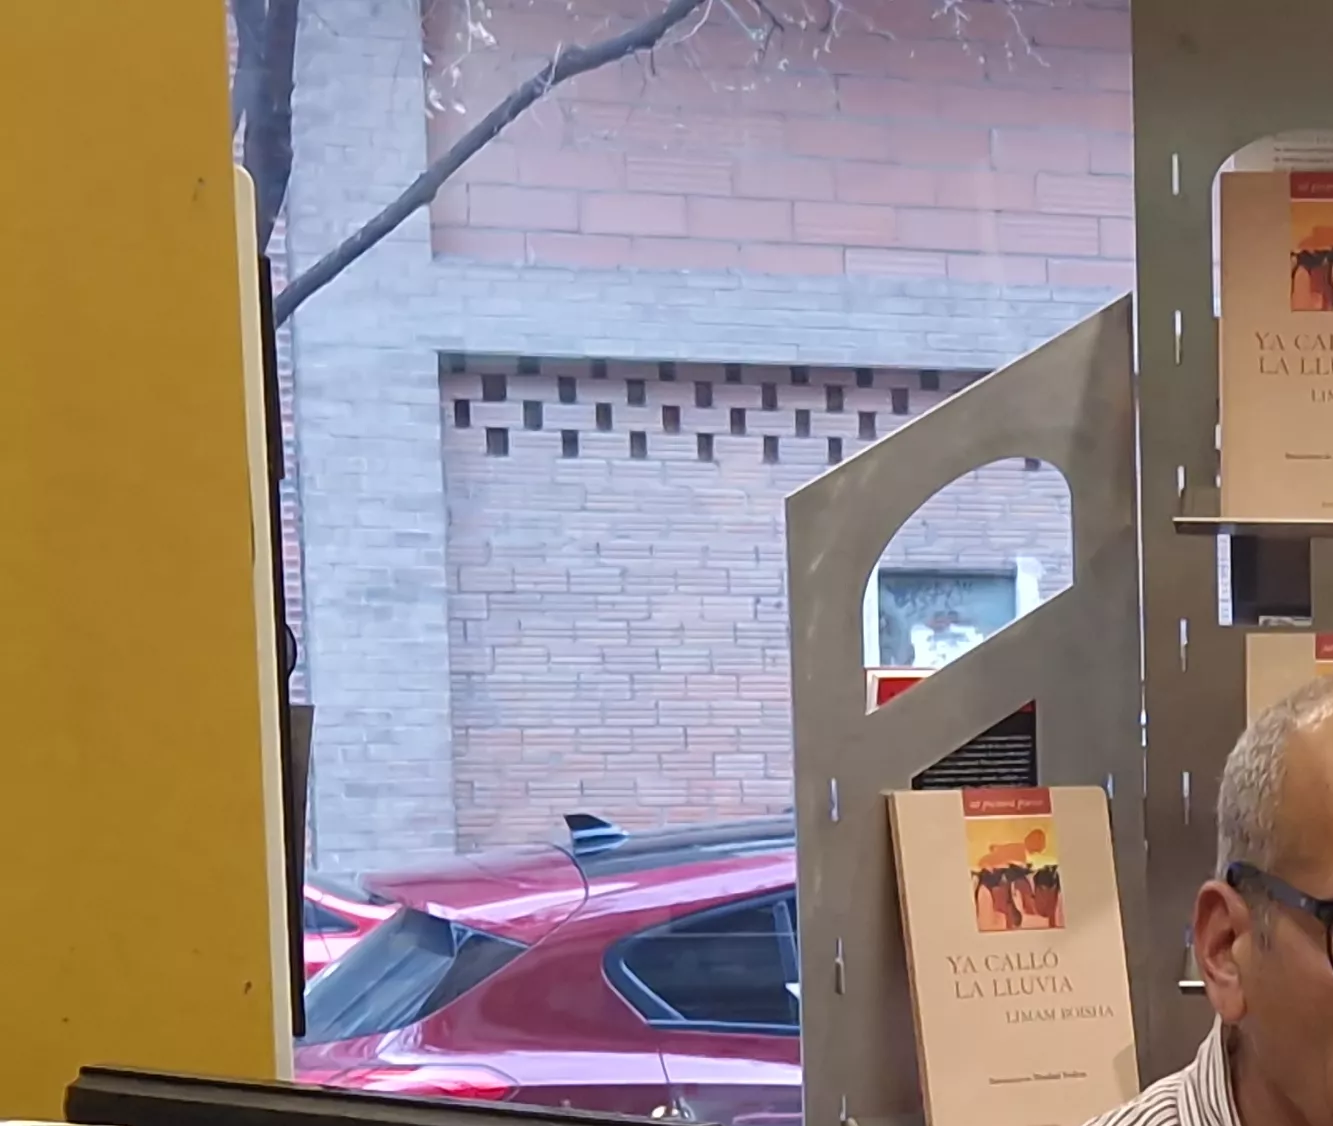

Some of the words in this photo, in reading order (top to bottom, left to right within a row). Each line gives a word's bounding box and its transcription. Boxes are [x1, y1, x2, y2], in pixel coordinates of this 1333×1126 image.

[1255, 332, 1286, 351] YA
[1259, 356, 1290, 376] LA
[946, 955, 977, 975] YA
[984, 948, 1059, 972] CALLÓ
[955, 980, 985, 1000] LA
[993, 975, 1074, 997] LLUVIA
